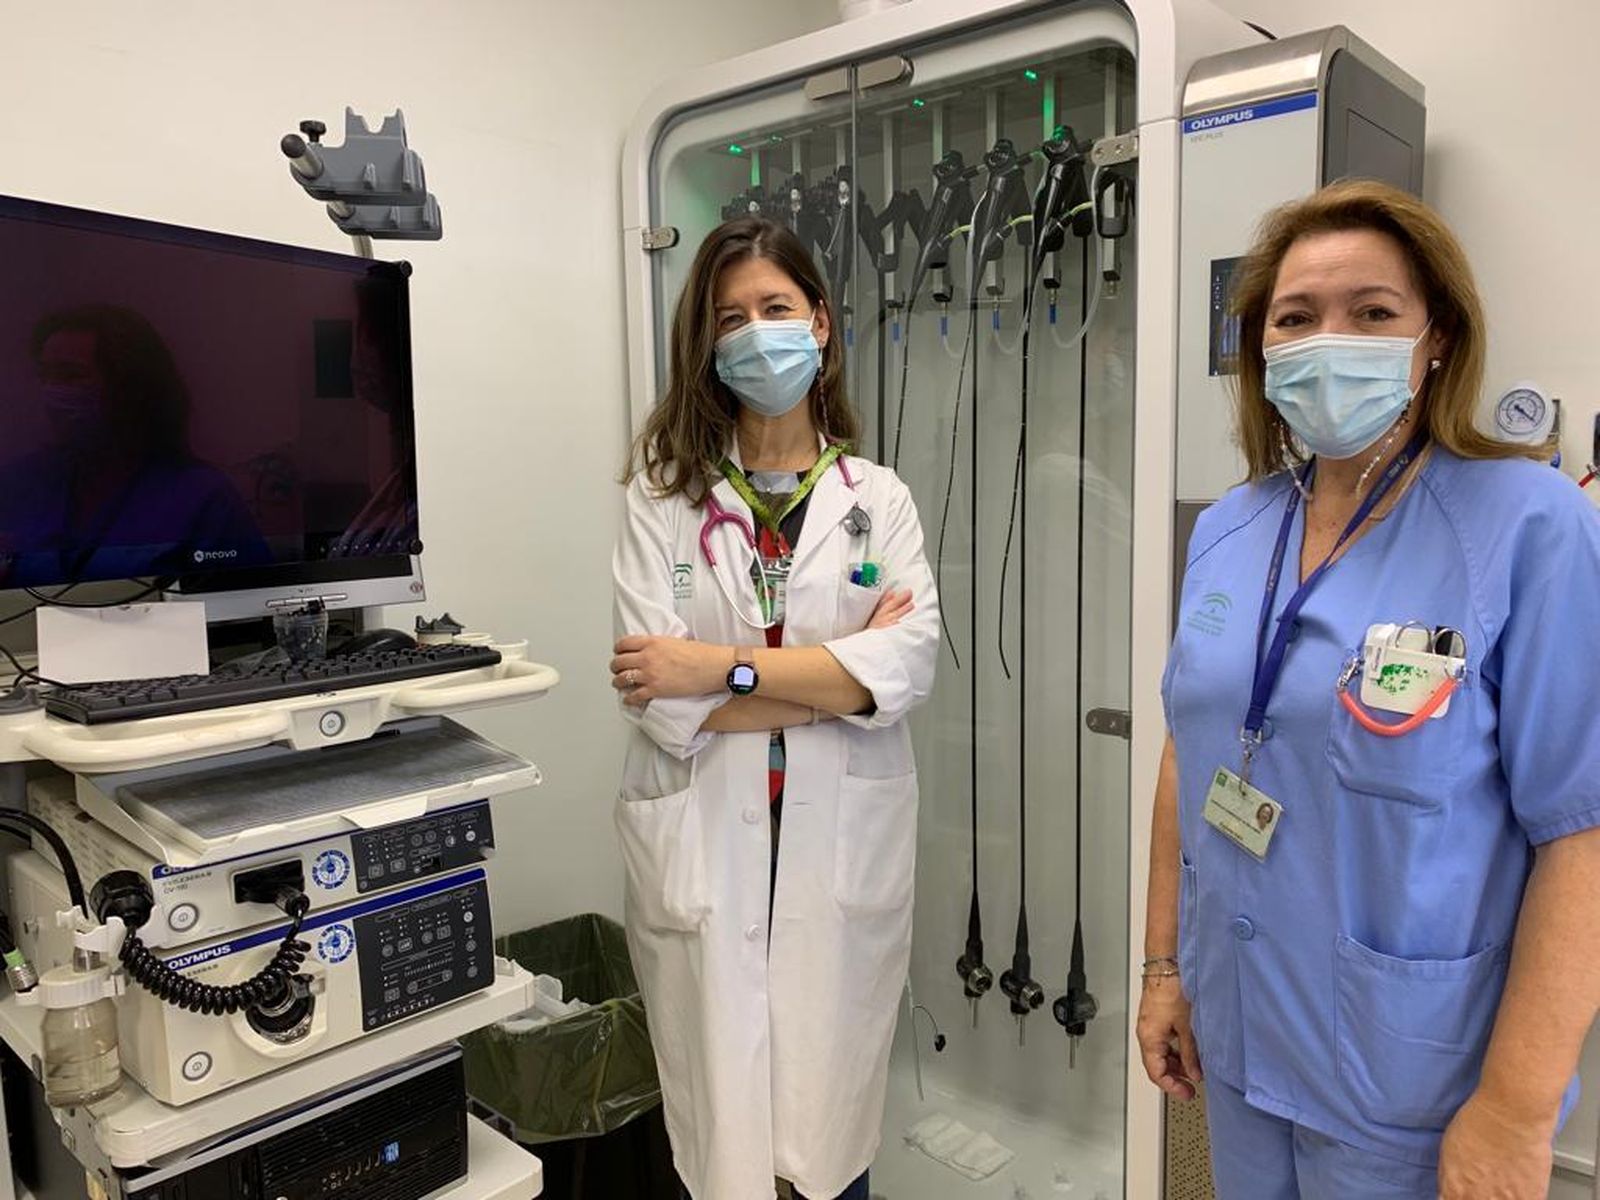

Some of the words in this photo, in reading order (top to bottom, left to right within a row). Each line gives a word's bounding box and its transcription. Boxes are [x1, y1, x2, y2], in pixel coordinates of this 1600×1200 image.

[1191, 109, 1254, 130] OLYMPUS
[205, 550, 237, 560] neovo
[168, 944, 232, 970] OLYMPUS
